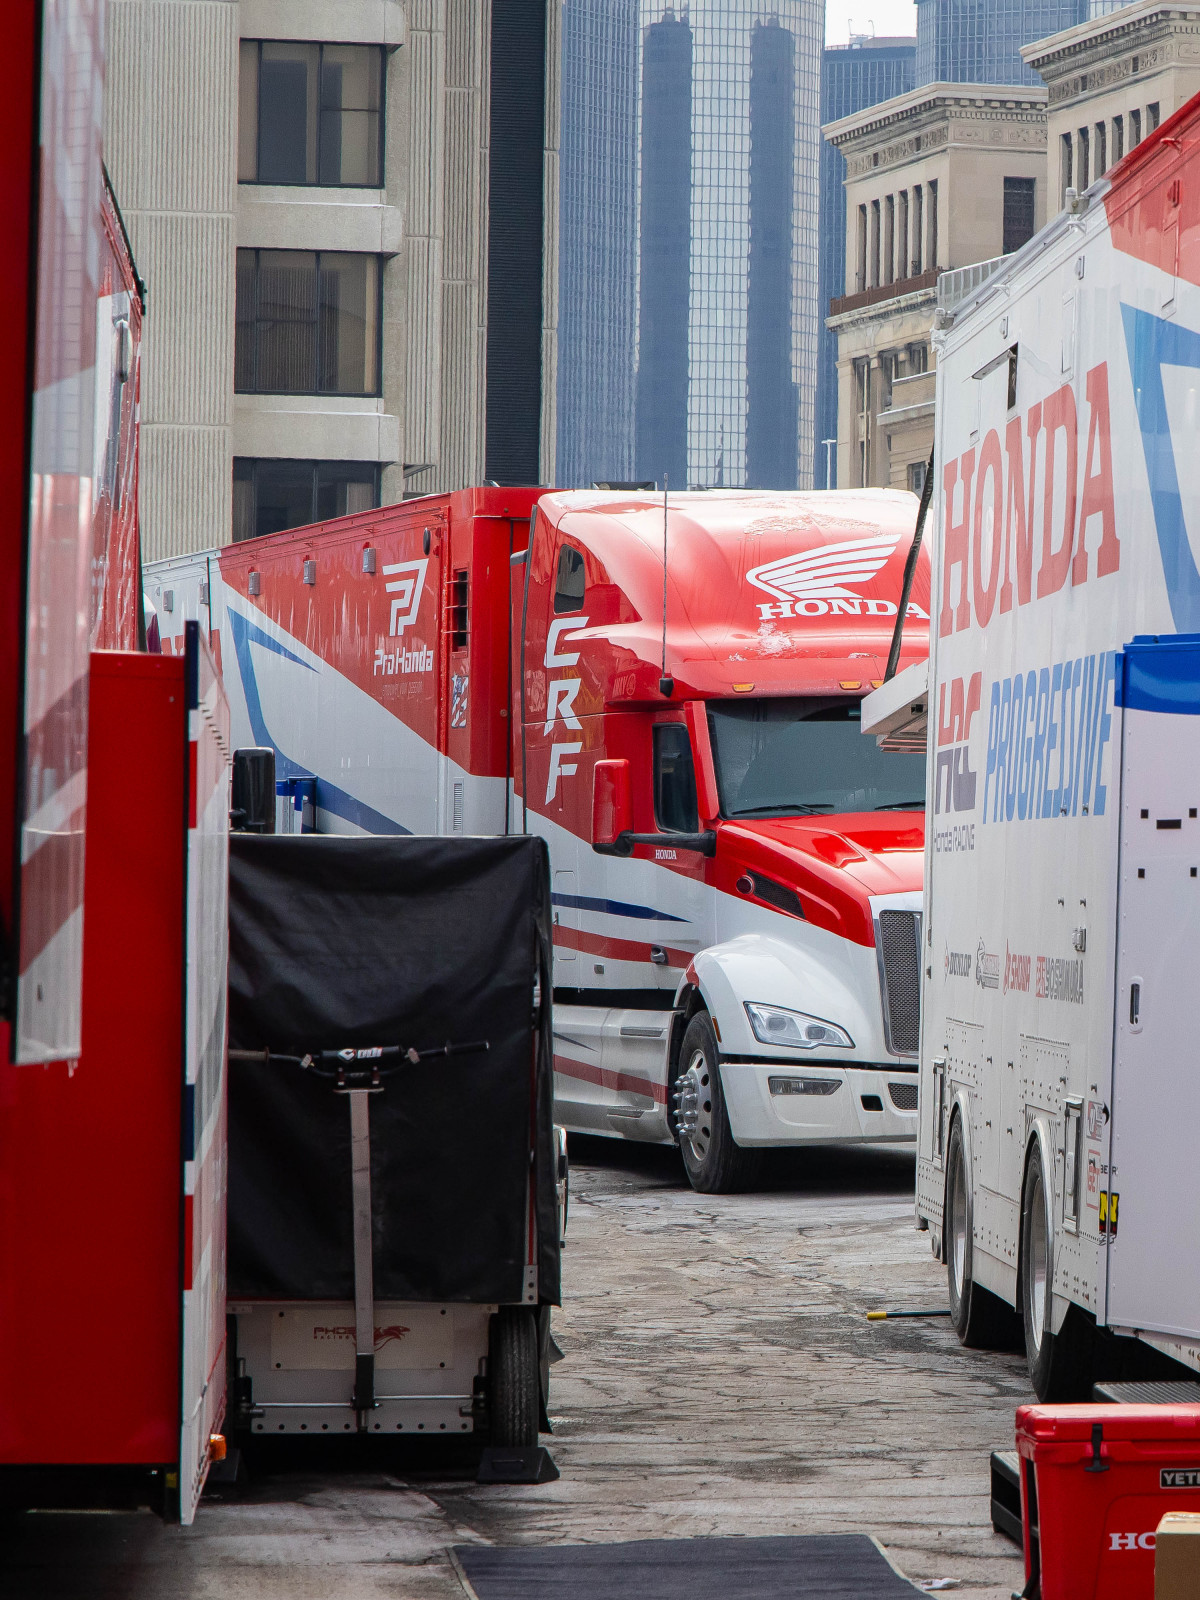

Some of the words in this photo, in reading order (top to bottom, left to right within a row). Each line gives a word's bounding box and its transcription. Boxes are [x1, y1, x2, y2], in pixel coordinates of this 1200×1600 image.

[940, 361, 1120, 638] HONDA
[756, 599, 930, 620] HONDA
[544, 616, 589, 805] CRF
[934, 671, 982, 815] HRC
[982, 650, 1115, 825] PROGRESSIVE
[655, 849, 677, 860] HONDA
[949, 952, 972, 978] DUNLOP
[313, 1326, 382, 1335] PHOEX
